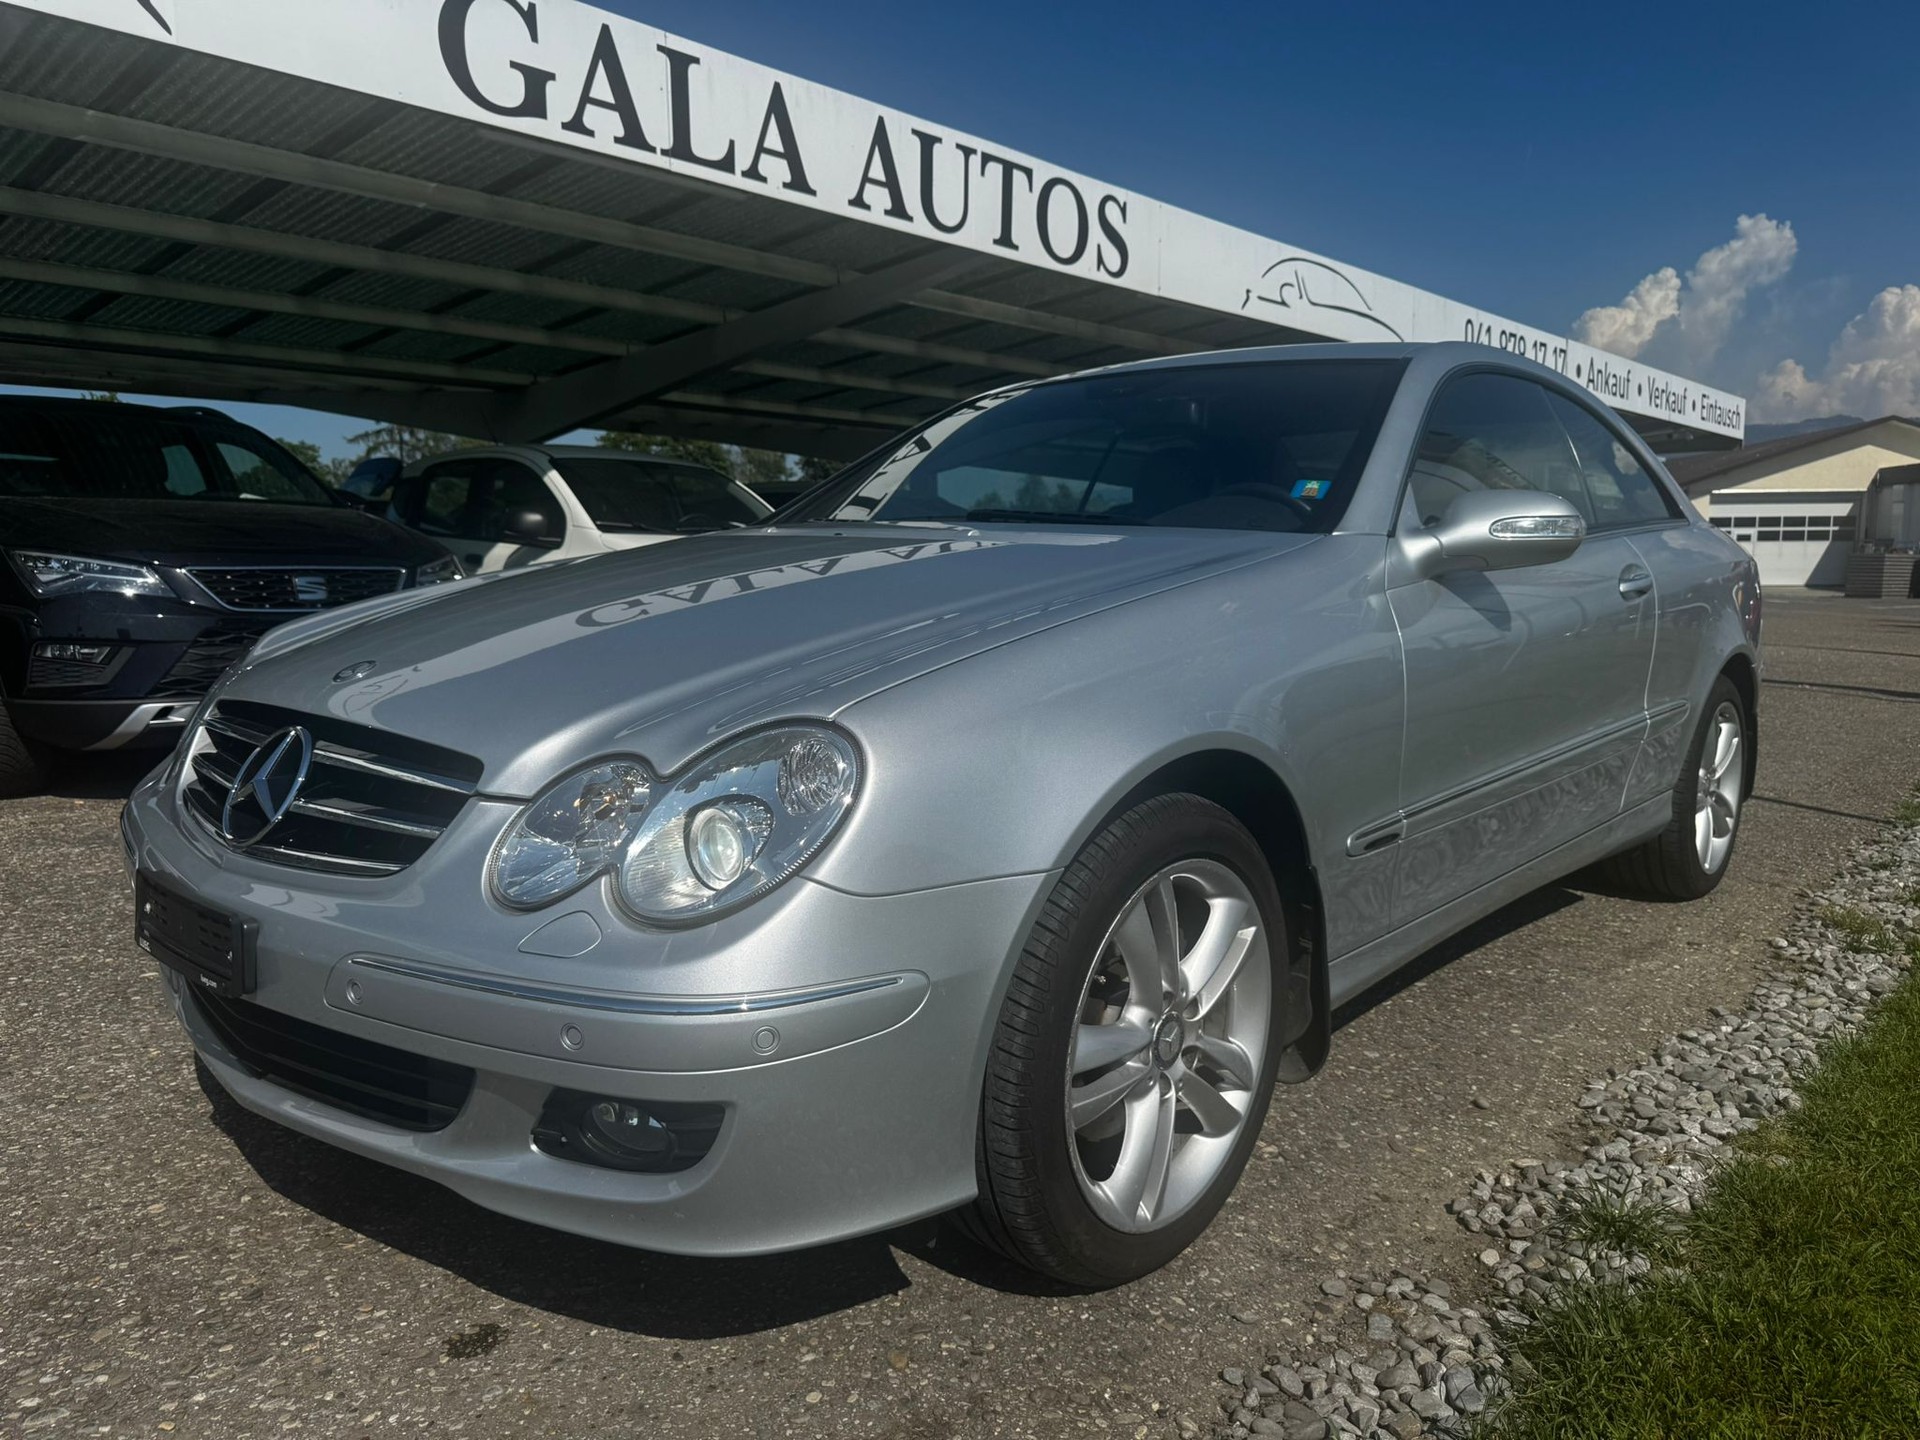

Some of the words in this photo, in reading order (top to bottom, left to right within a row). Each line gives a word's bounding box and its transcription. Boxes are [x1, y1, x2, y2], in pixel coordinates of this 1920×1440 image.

[437, 0, 818, 198] GALA
[847, 114, 1129, 279] AUTOS
[1586, 356, 1632, 401] Ankauf
[1647, 375, 1688, 416] Verkauf
[1700, 393, 1741, 431] Eintausch
